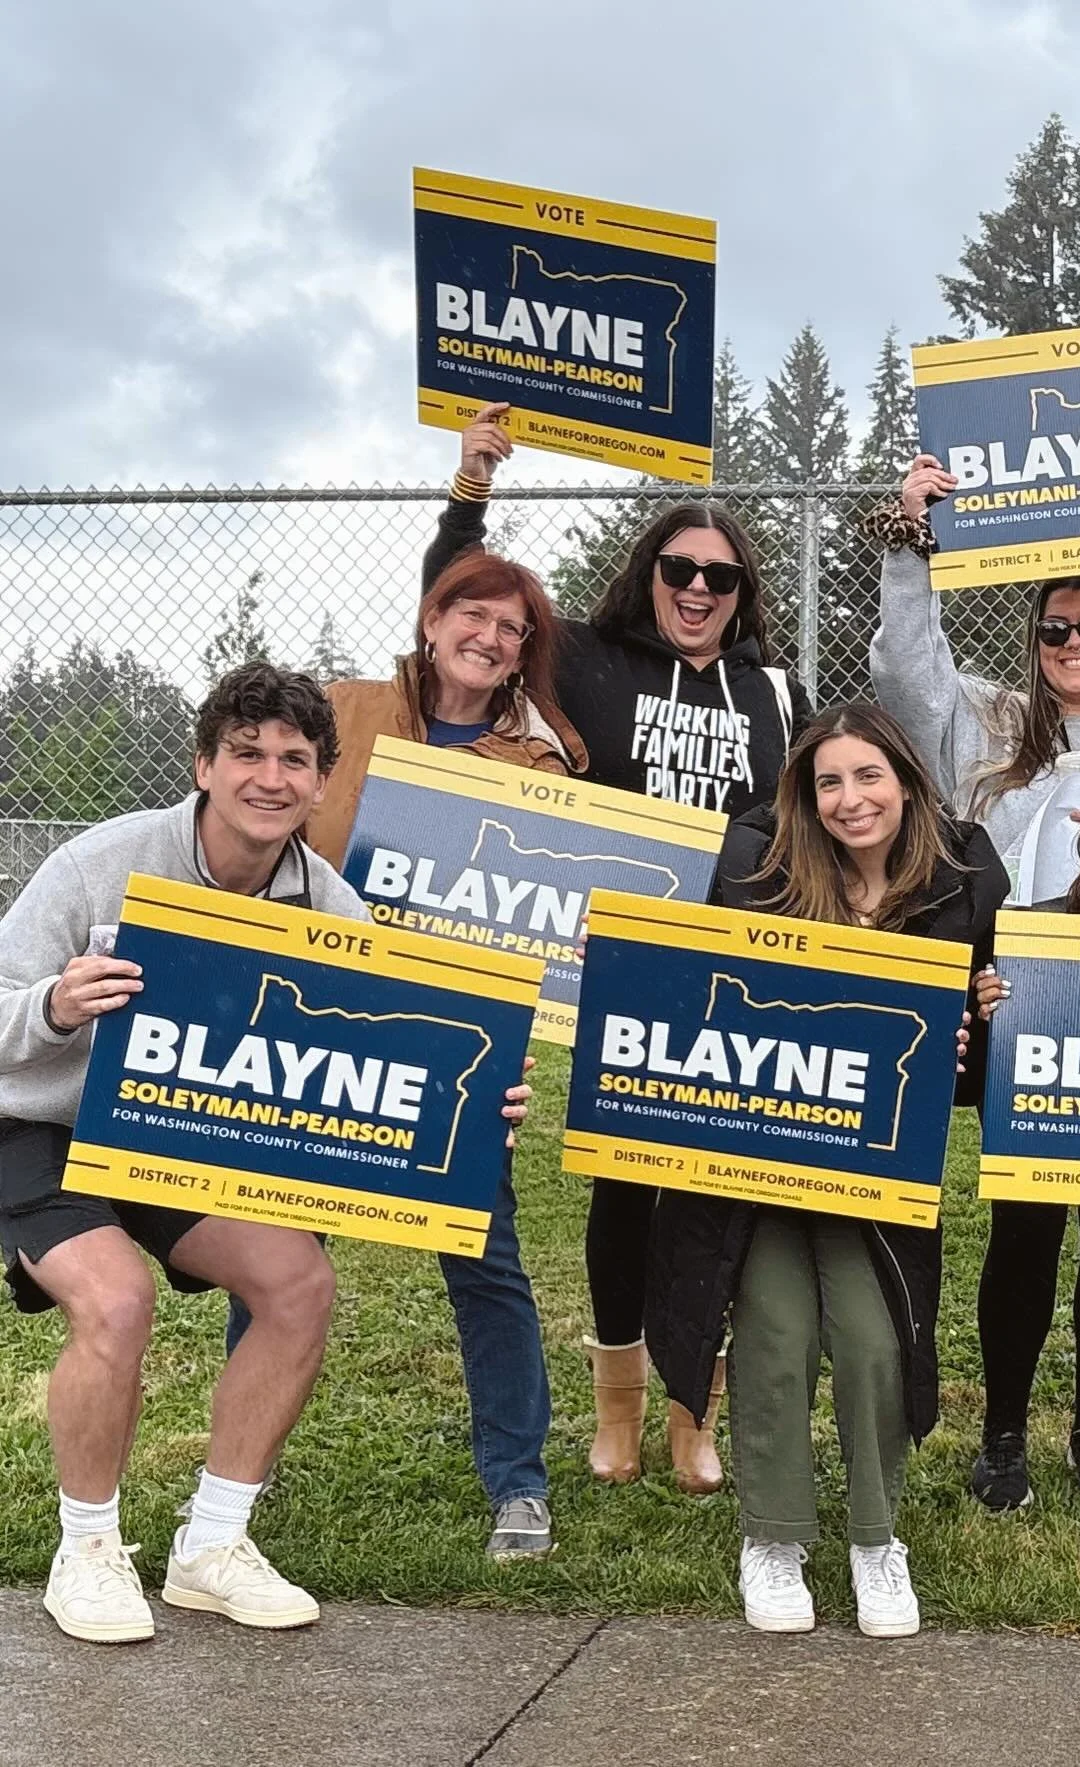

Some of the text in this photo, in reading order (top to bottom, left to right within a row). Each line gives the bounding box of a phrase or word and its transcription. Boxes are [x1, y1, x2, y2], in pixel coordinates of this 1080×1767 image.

[535, 202, 584, 226] VOTE
[436, 282, 643, 368] BLAYNE
[437, 359, 642, 409] FOR WASHINGTON COUNTY COMMISSIONER
[438, 336, 642, 393] SOLEYMANI-PEARSON
[456, 406, 501, 424] DISTT
[504, 416, 510, 426] 2
[528, 421, 665, 459] BLAYNEFOROREGON.COM
[955, 519, 975, 528] FOR
[978, 510, 1051, 526] WASHINGTON
[979, 554, 1031, 568] DISTRICT
[1033, 552, 1041, 562] 2
[634, 693, 750, 746] WORKING
[630, 724, 747, 782] FAMILIES
[520, 781, 577, 807] VOTE
[645, 766, 731, 813] PARTY
[363, 847, 588, 940] BLAYN
[306, 926, 373, 956] VOTE
[364, 901, 583, 965] OLEYMANI-PEARS
[747, 927, 808, 952] VOTE
[123, 1013, 427, 1121] BLAYNE
[600, 1014, 869, 1103] BLAYNE
[118, 1079, 414, 1150] SOLEYMANI-PEARSON
[595, 1098, 858, 1147] FOR WASHINGTON COUNTY COMMISSIONER
[599, 1072, 862, 1129] SOLEYMANI-PEARSON
[1010, 1119, 1034, 1130] FOR
[112, 1107, 408, 1169] FOR WASHINGTON COUNTY COMMISSIONER
[128, 1166, 428, 1227] DISTRICT 2 BLAYNEFOROREGON.COM
[614, 1149, 881, 1200] DISTRICT 2 BLAYNEFOROREGON.COM
